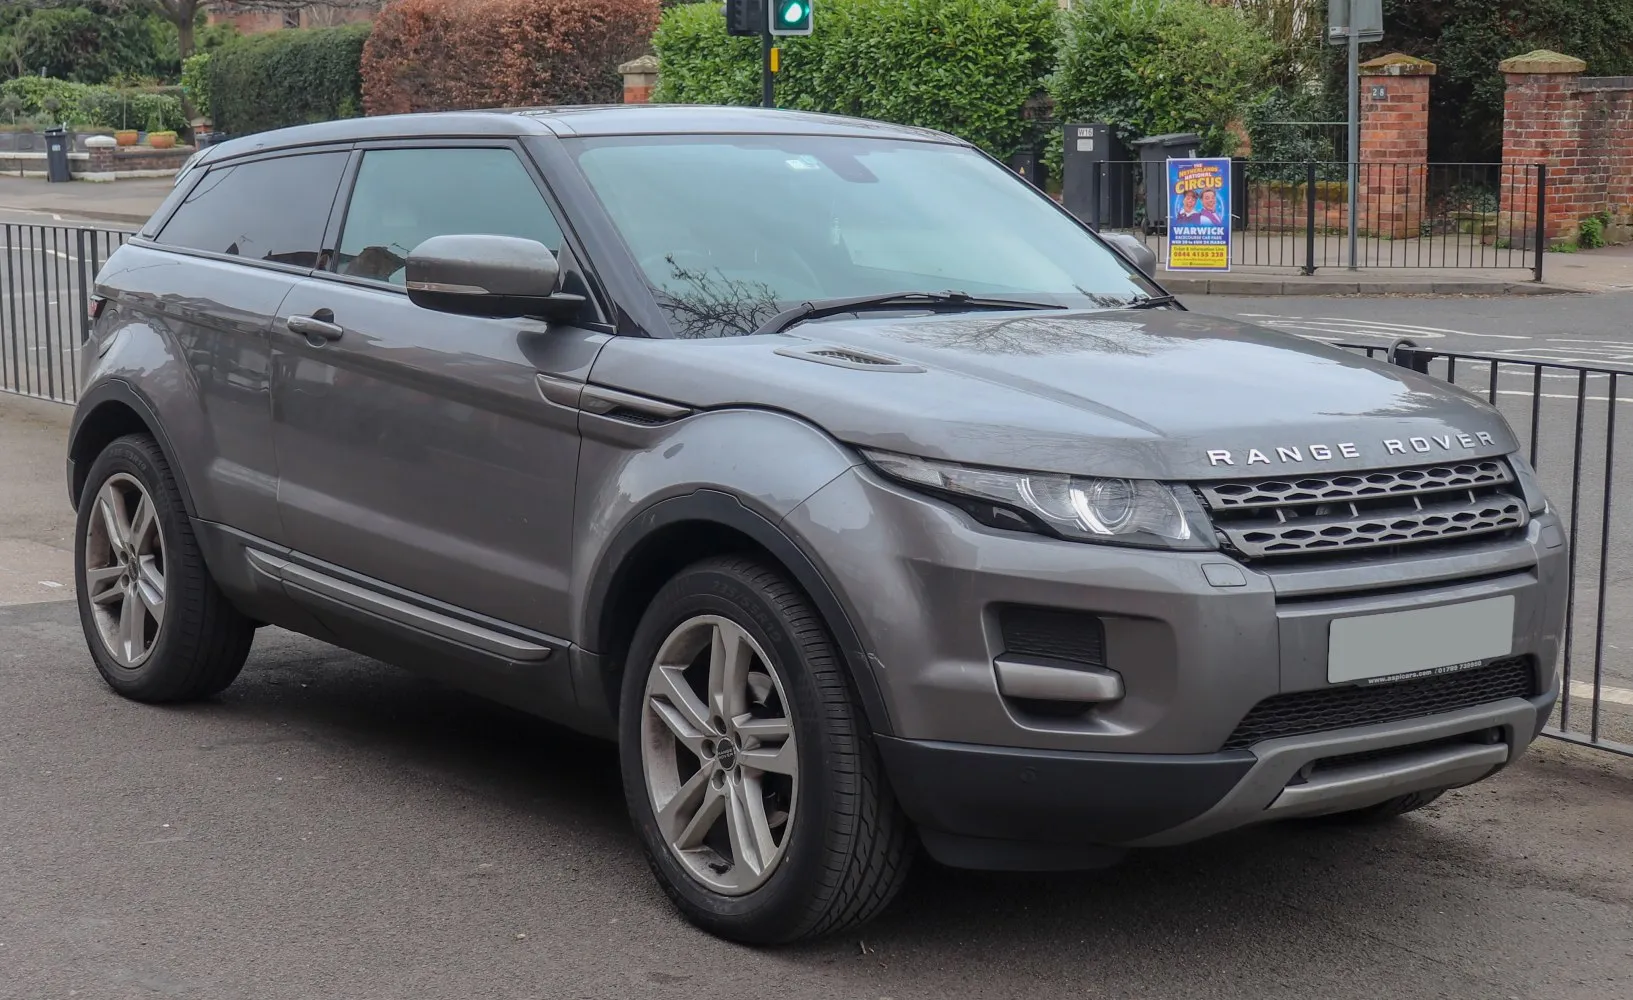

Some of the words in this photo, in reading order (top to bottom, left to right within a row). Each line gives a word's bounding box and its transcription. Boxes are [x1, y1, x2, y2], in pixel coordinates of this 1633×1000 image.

[1179, 166, 1219, 178] NETHERLANDS
[1184, 172, 1211, 180] NATIONAL
[1175, 176, 1223, 194] CIRCUS
[1173, 226, 1225, 236] WARWICK
[1206, 442, 1360, 466] RANGE
[1382, 431, 1496, 455] ROVER
